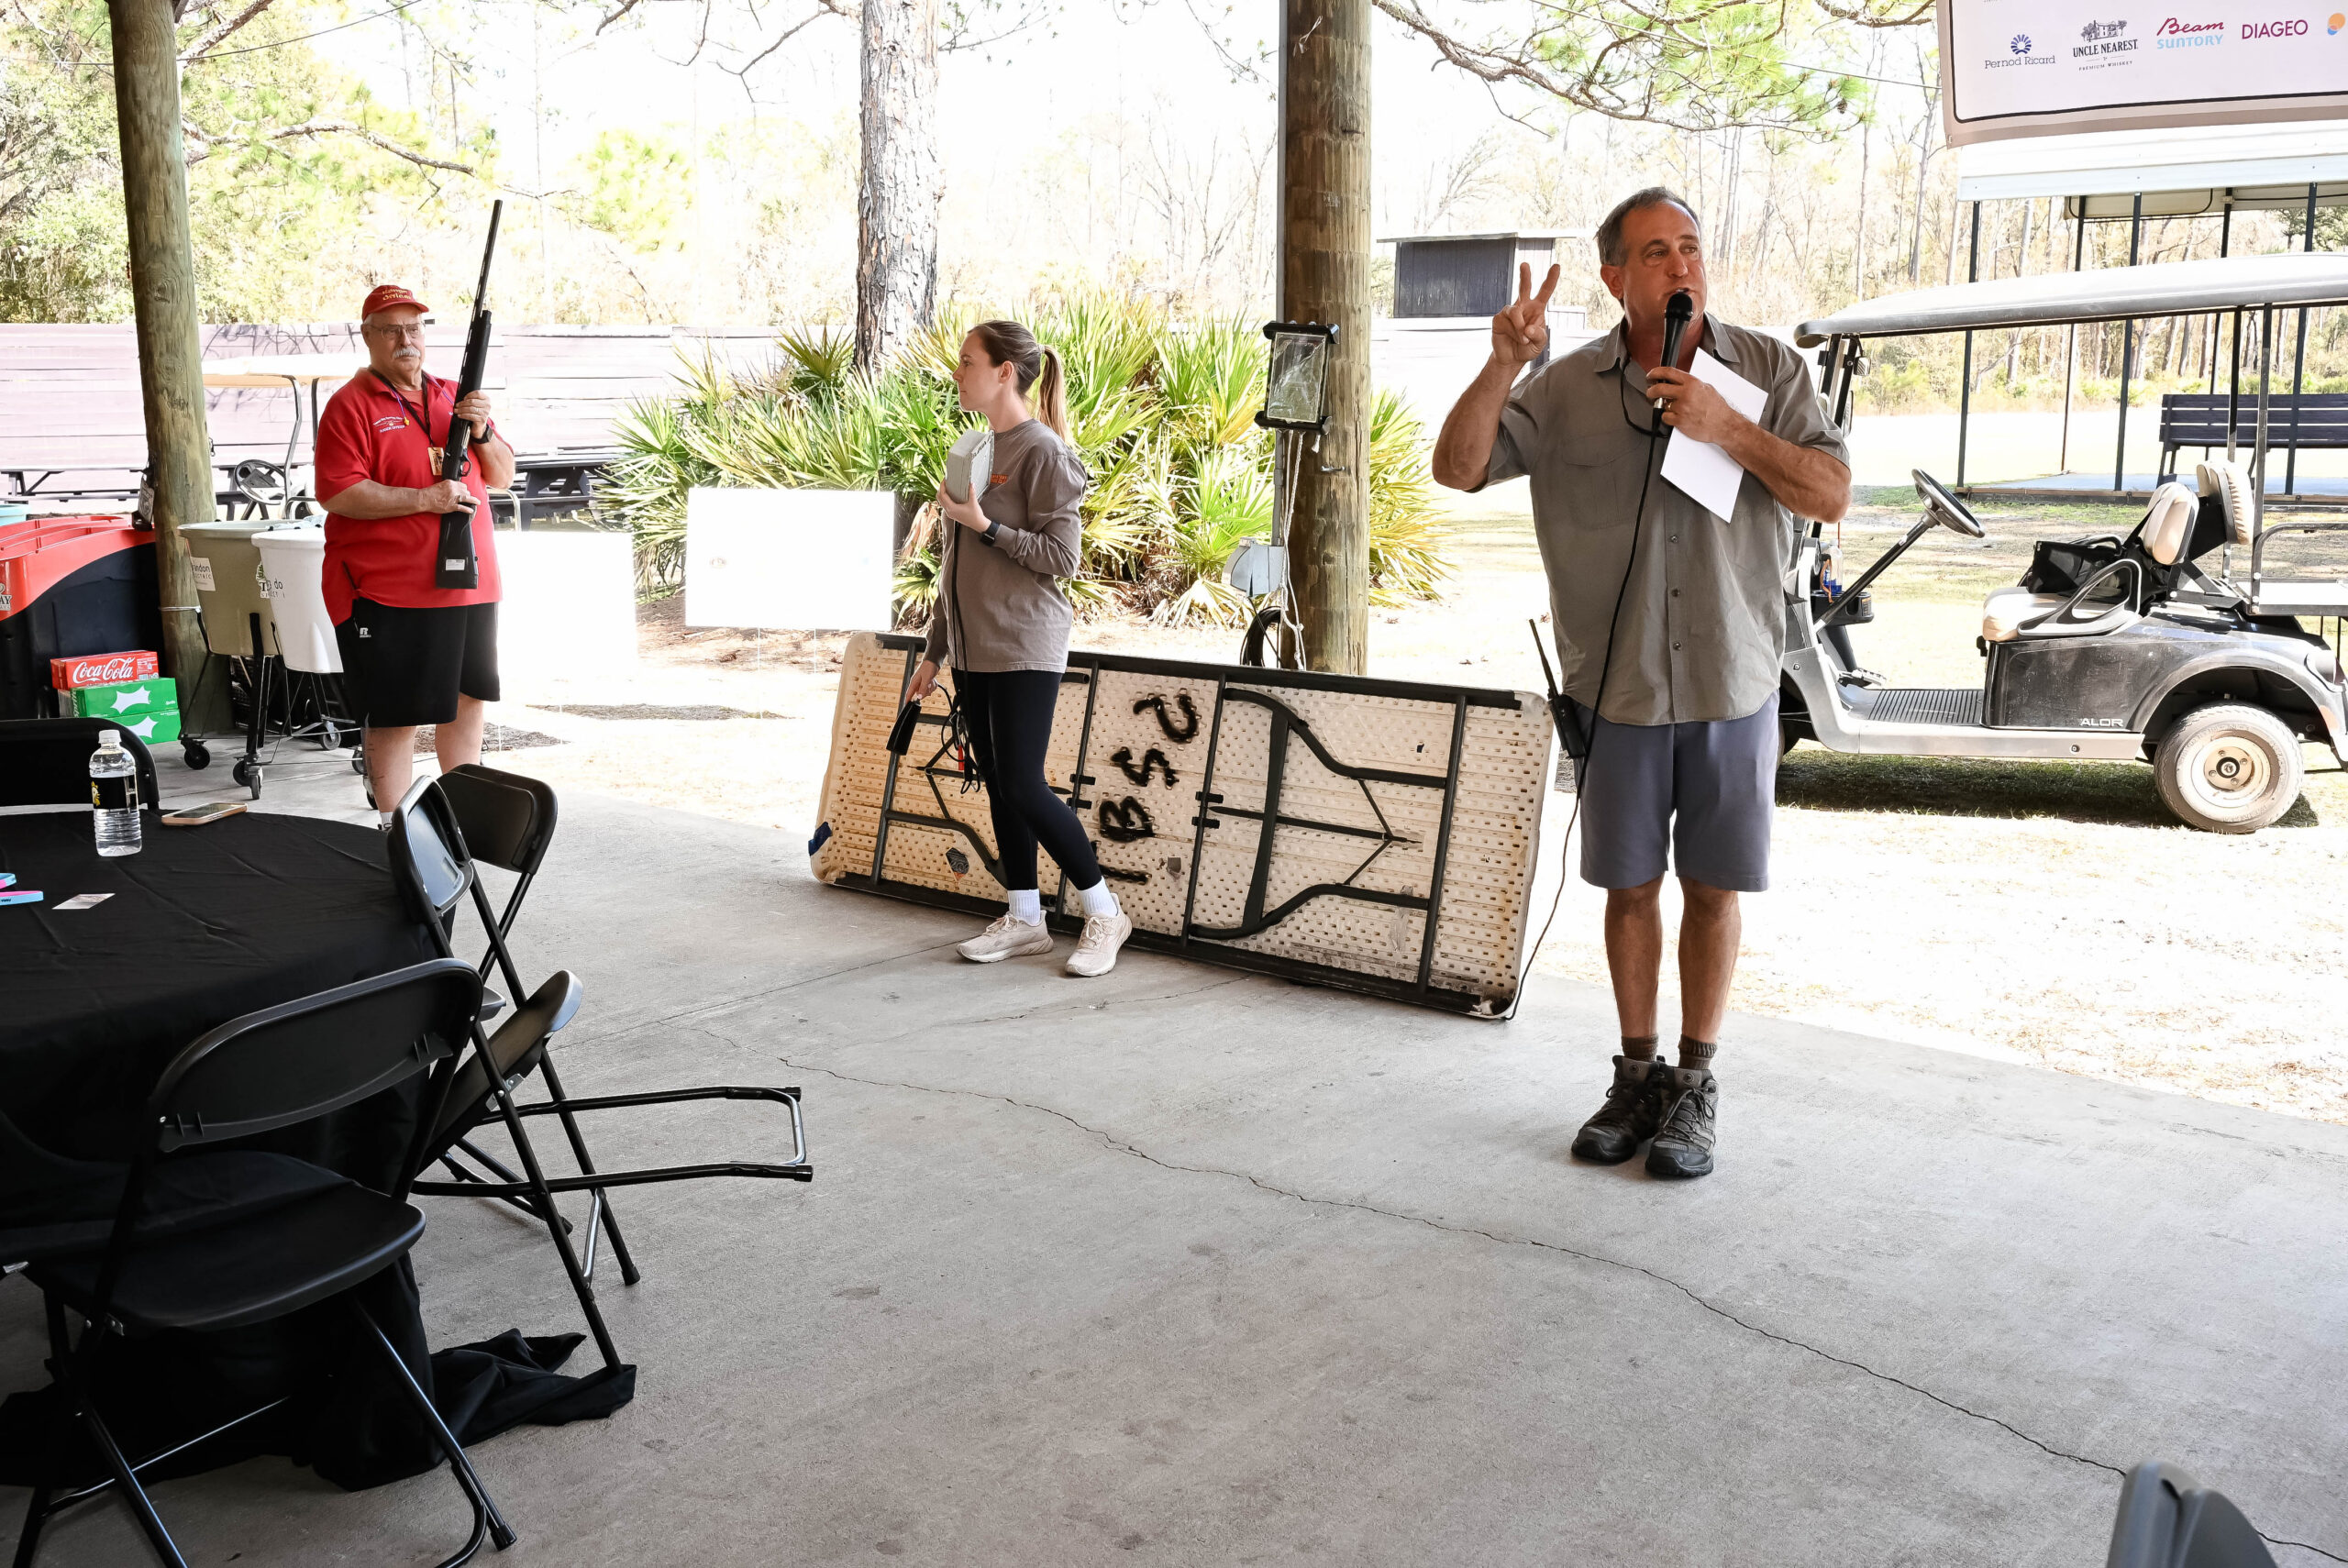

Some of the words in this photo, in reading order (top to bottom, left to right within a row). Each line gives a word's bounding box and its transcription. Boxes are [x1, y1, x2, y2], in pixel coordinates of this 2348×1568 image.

[2156, 17, 2224, 36] Beam
[2242, 19, 2309, 39] DIAGEO
[2073, 44, 2099, 58] UNCLE
[2100, 39, 2139, 54] NEAREST
[2156, 34, 2224, 50] SUNTORY
[1985, 56, 2021, 69] Pernod
[2024, 54, 2055, 65] Ricard
[72, 657, 136, 684] Coca-Cola
[2079, 717, 2124, 727] ALOR
